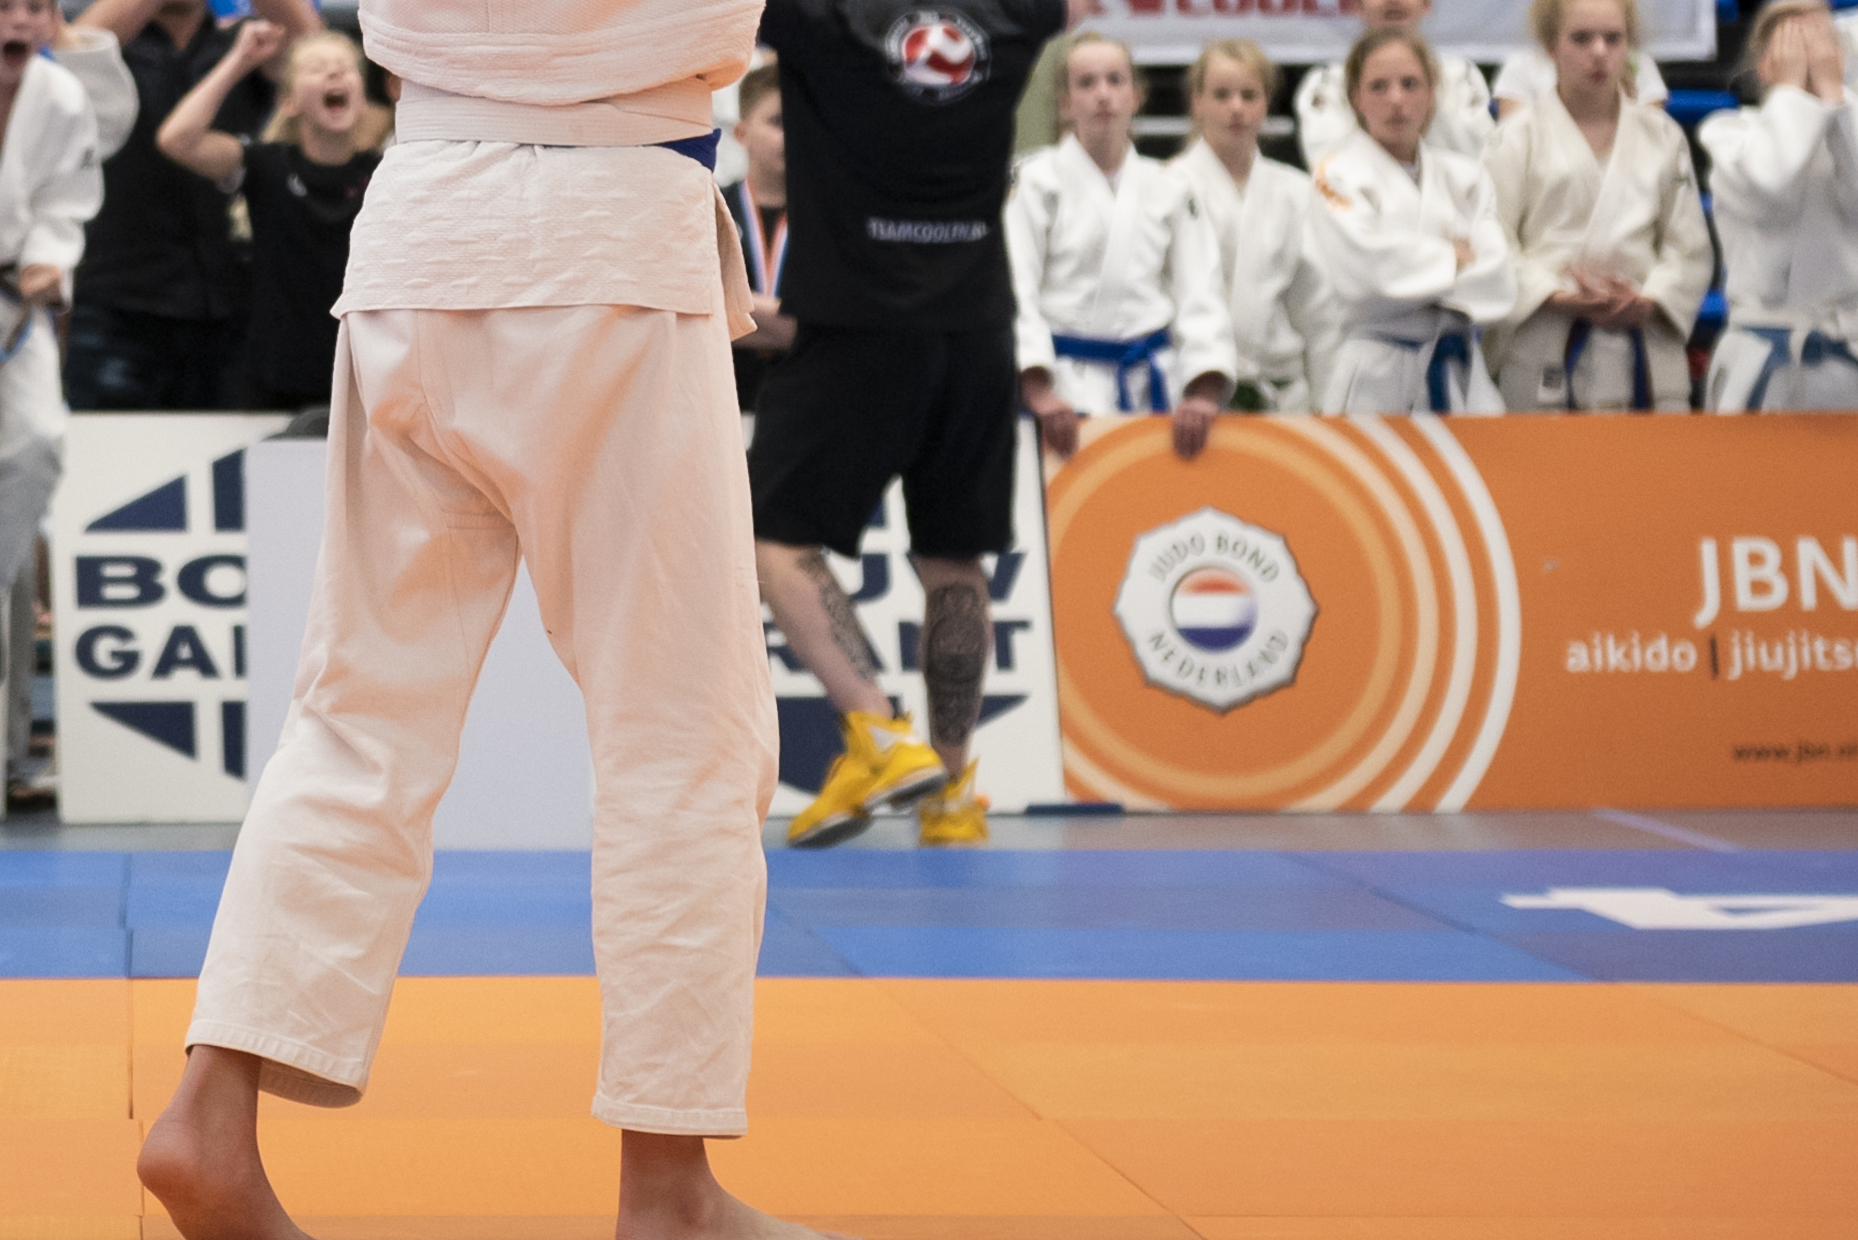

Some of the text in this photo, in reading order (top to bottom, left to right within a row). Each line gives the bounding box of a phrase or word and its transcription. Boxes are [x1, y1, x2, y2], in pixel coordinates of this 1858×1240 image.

[1148, 531, 1280, 582] JUDO BOND
[1693, 534, 1858, 630] JBN
[1148, 629, 1289, 688] NEDERLAND
[1566, 628, 1858, 681] aikido jiujits
